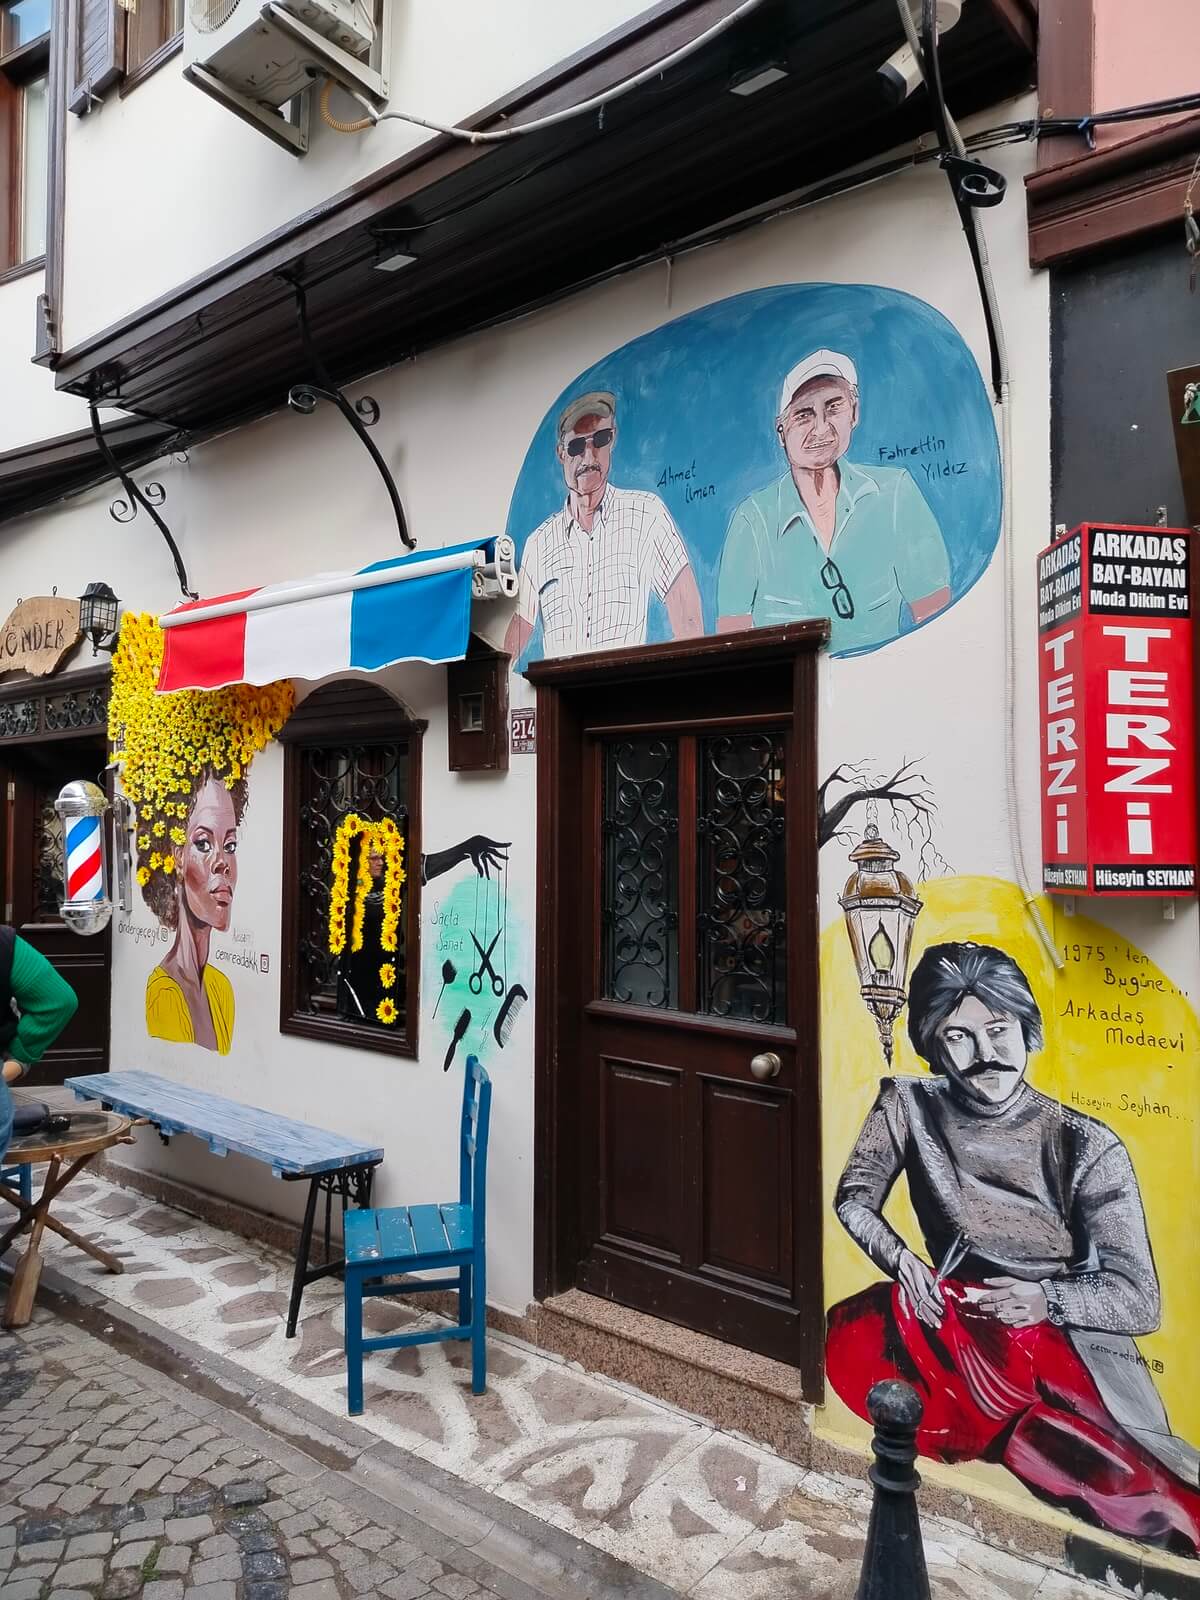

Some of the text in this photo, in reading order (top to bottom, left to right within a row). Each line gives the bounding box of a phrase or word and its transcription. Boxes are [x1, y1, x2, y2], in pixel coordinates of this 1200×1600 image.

[878, 435, 945, 461] Fahrettin
[657, 459, 696, 488] Ahmet
[1039, 536, 1081, 581] ARKADAŞ
[1092, 532, 1187, 565] ARKADAŞ
[1040, 567, 1081, 606] BAY-BAYAN
[1092, 563, 1186, 588] BAY-BAYAN
[1039, 592, 1082, 627] Moda Dikim Evi
[1090, 590, 1189, 610] Moda Dikim Evi
[0, 619, 65, 659] ÖNDER
[512, 719, 535, 739] 214
[1064, 869, 1087, 886] SEYHAN
[1095, 869, 1195, 888] Hüseyin SEYHAN
[1060, 1000, 1145, 1025] Arkadaş
[1106, 1027, 1184, 1052] Modaevi
